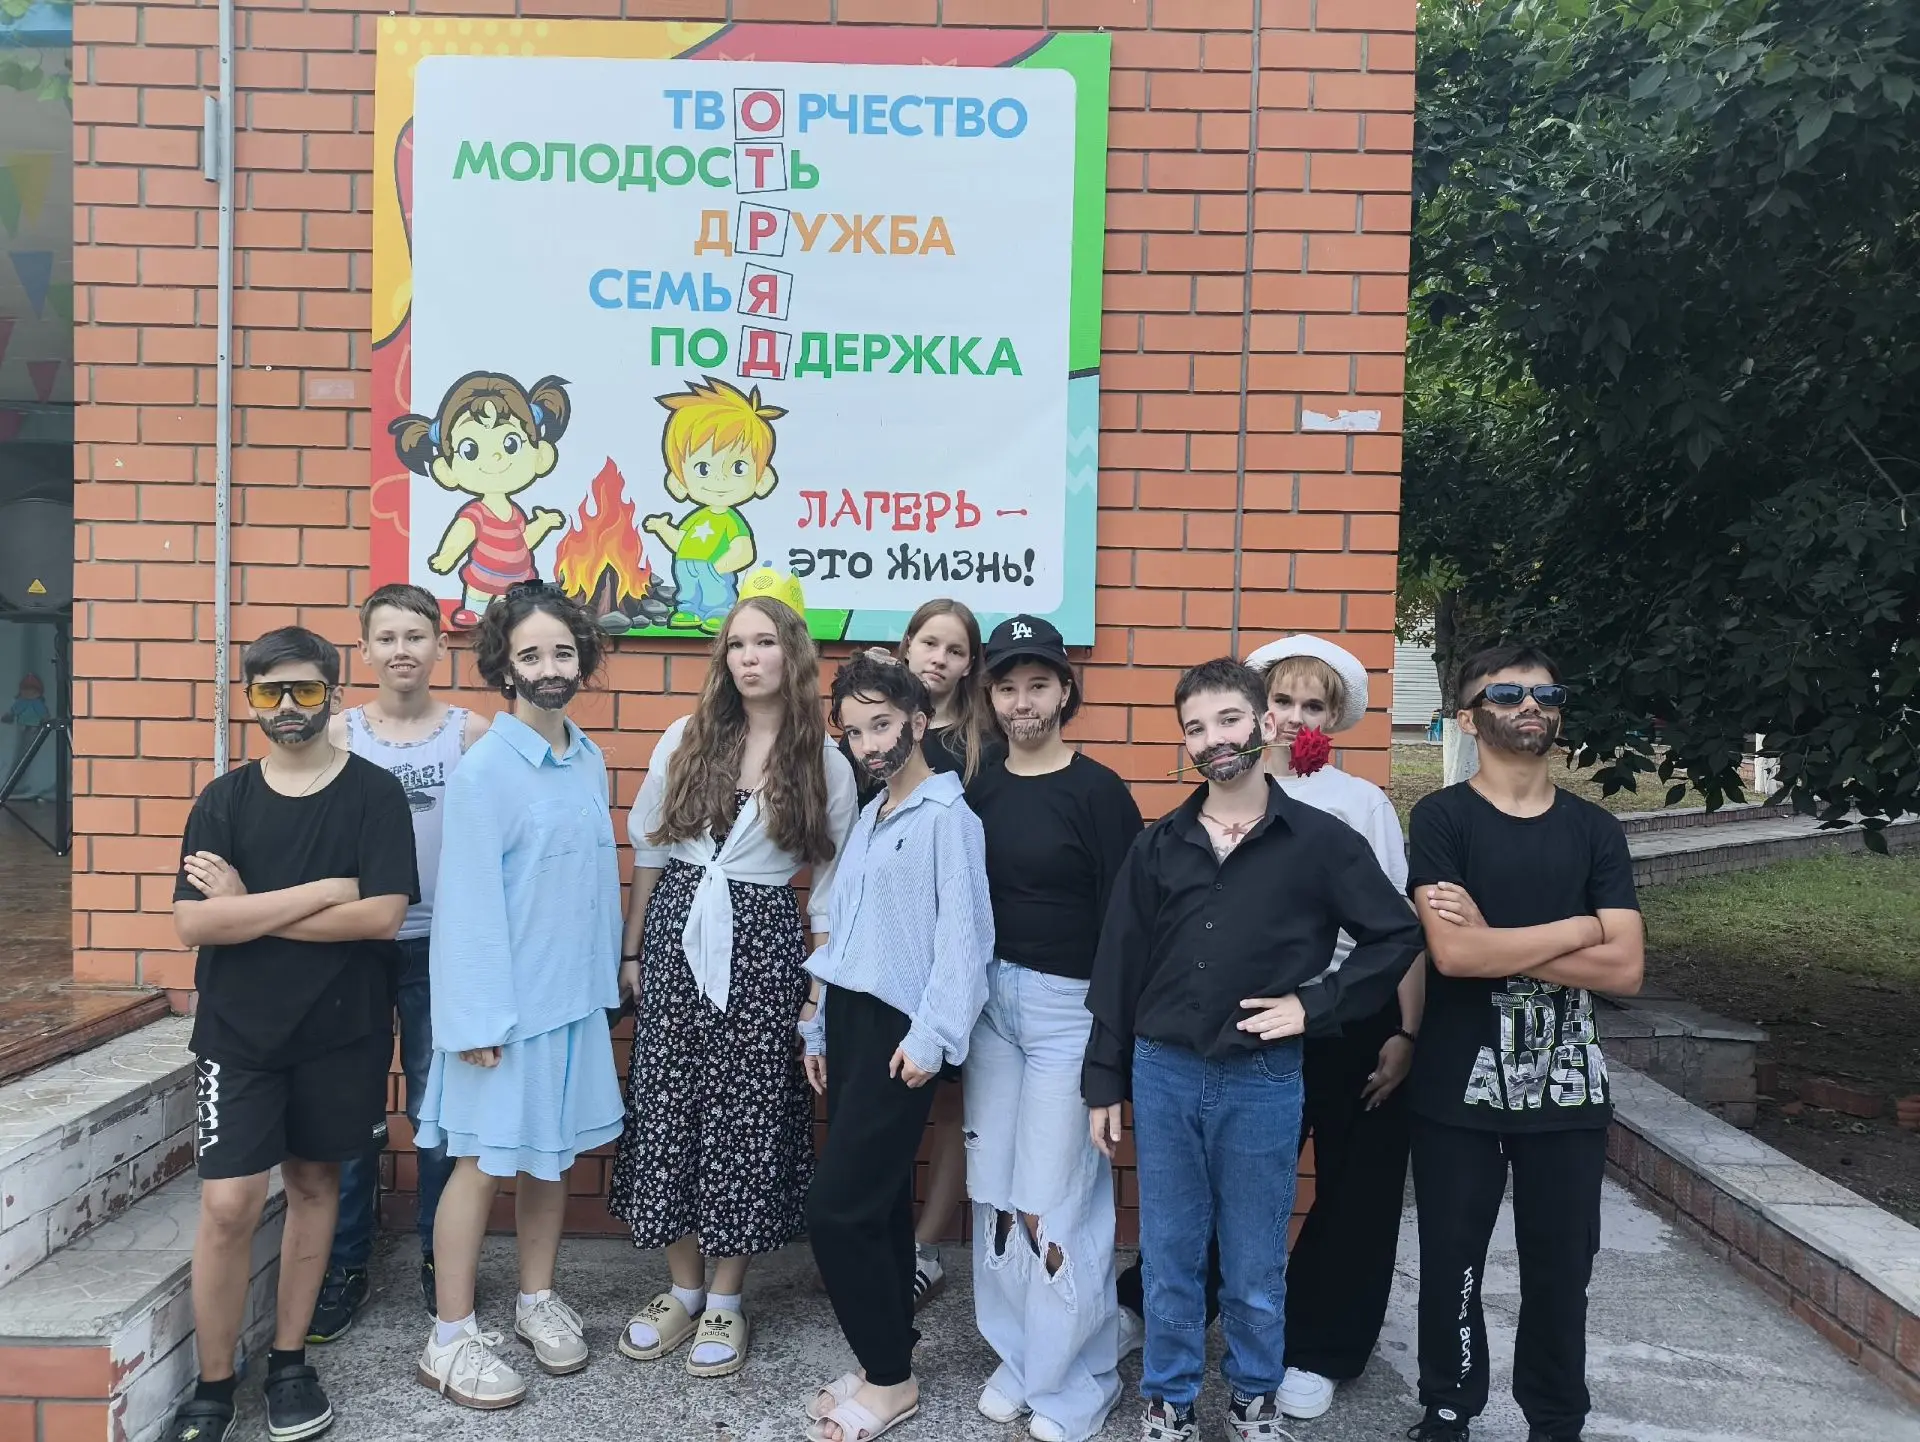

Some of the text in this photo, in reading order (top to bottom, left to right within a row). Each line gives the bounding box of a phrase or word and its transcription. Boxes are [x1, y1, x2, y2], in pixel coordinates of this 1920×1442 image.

[663, 90, 1029, 140] ТВОРЧЕСТВО
[453, 140, 819, 192] МОЛОДОСТЬ
[695, 211, 953, 257] ДРУЖБА
[588, 268, 779, 313] СЕМЬЯ
[650, 327, 1022, 379] ПОДДЕРЖКА
[797, 488, 981, 532] ЛАГЕРЬ
[1011, 621, 1033, 641] LA
